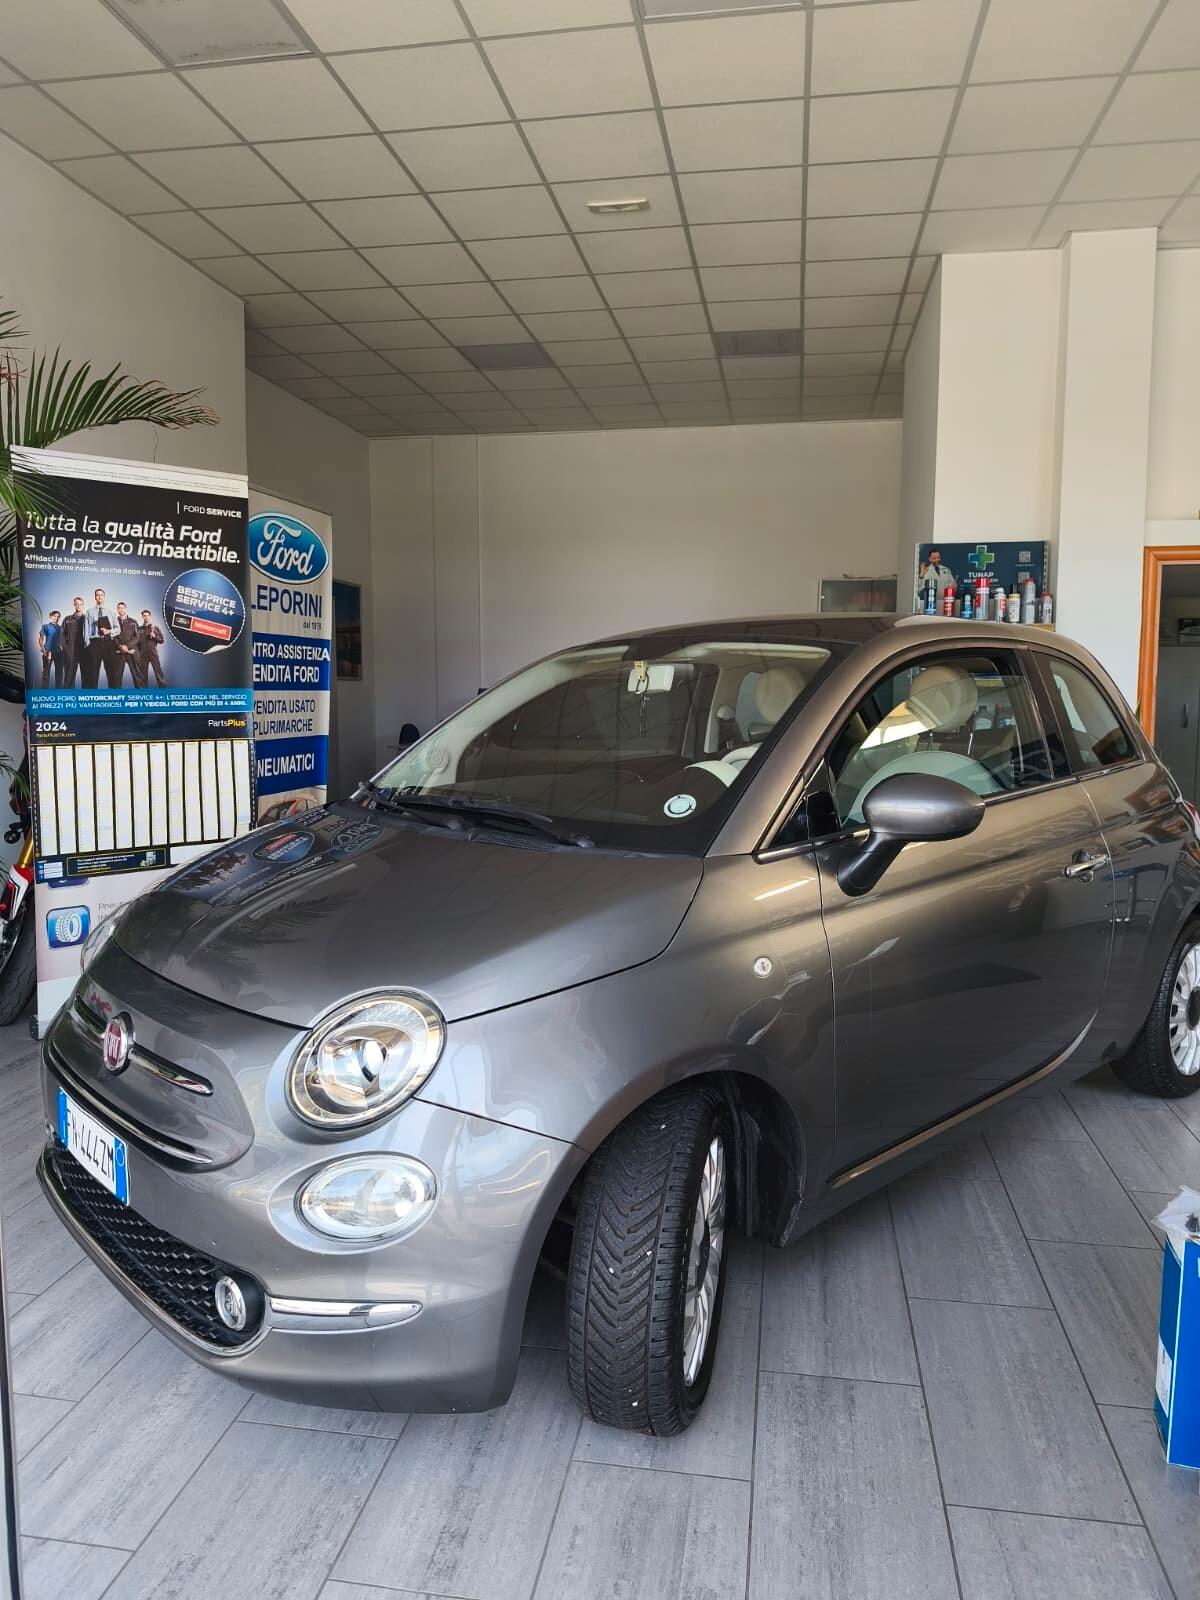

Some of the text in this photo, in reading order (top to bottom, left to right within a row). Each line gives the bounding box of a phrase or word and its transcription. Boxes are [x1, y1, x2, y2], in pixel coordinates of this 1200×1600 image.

[184, 505, 242, 518] FORD SERVICE
[25, 511, 222, 544] Tutta la qualità Ford
[23, 534, 240, 564] a un prezzo imbattibile.
[257, 520, 314, 576] Ford
[25, 554, 54, 562] Affidaci
[176, 594, 220, 613] SERVICE
[222, 608, 235, 616] 4+
[178, 586, 236, 608] BEST PRICE
[252, 585, 322, 618] EPORINI
[252, 642, 331, 661] NTRO ASSISTENZA
[253, 664, 320, 683] ENDITA FORD
[290, 699, 316, 714] USATO
[36, 722, 67, 732] 2024
[208, 719, 246, 727] PartsPlus
[253, 719, 313, 737] PLURIMARCHE
[257, 753, 315, 778] NEUMATICI
